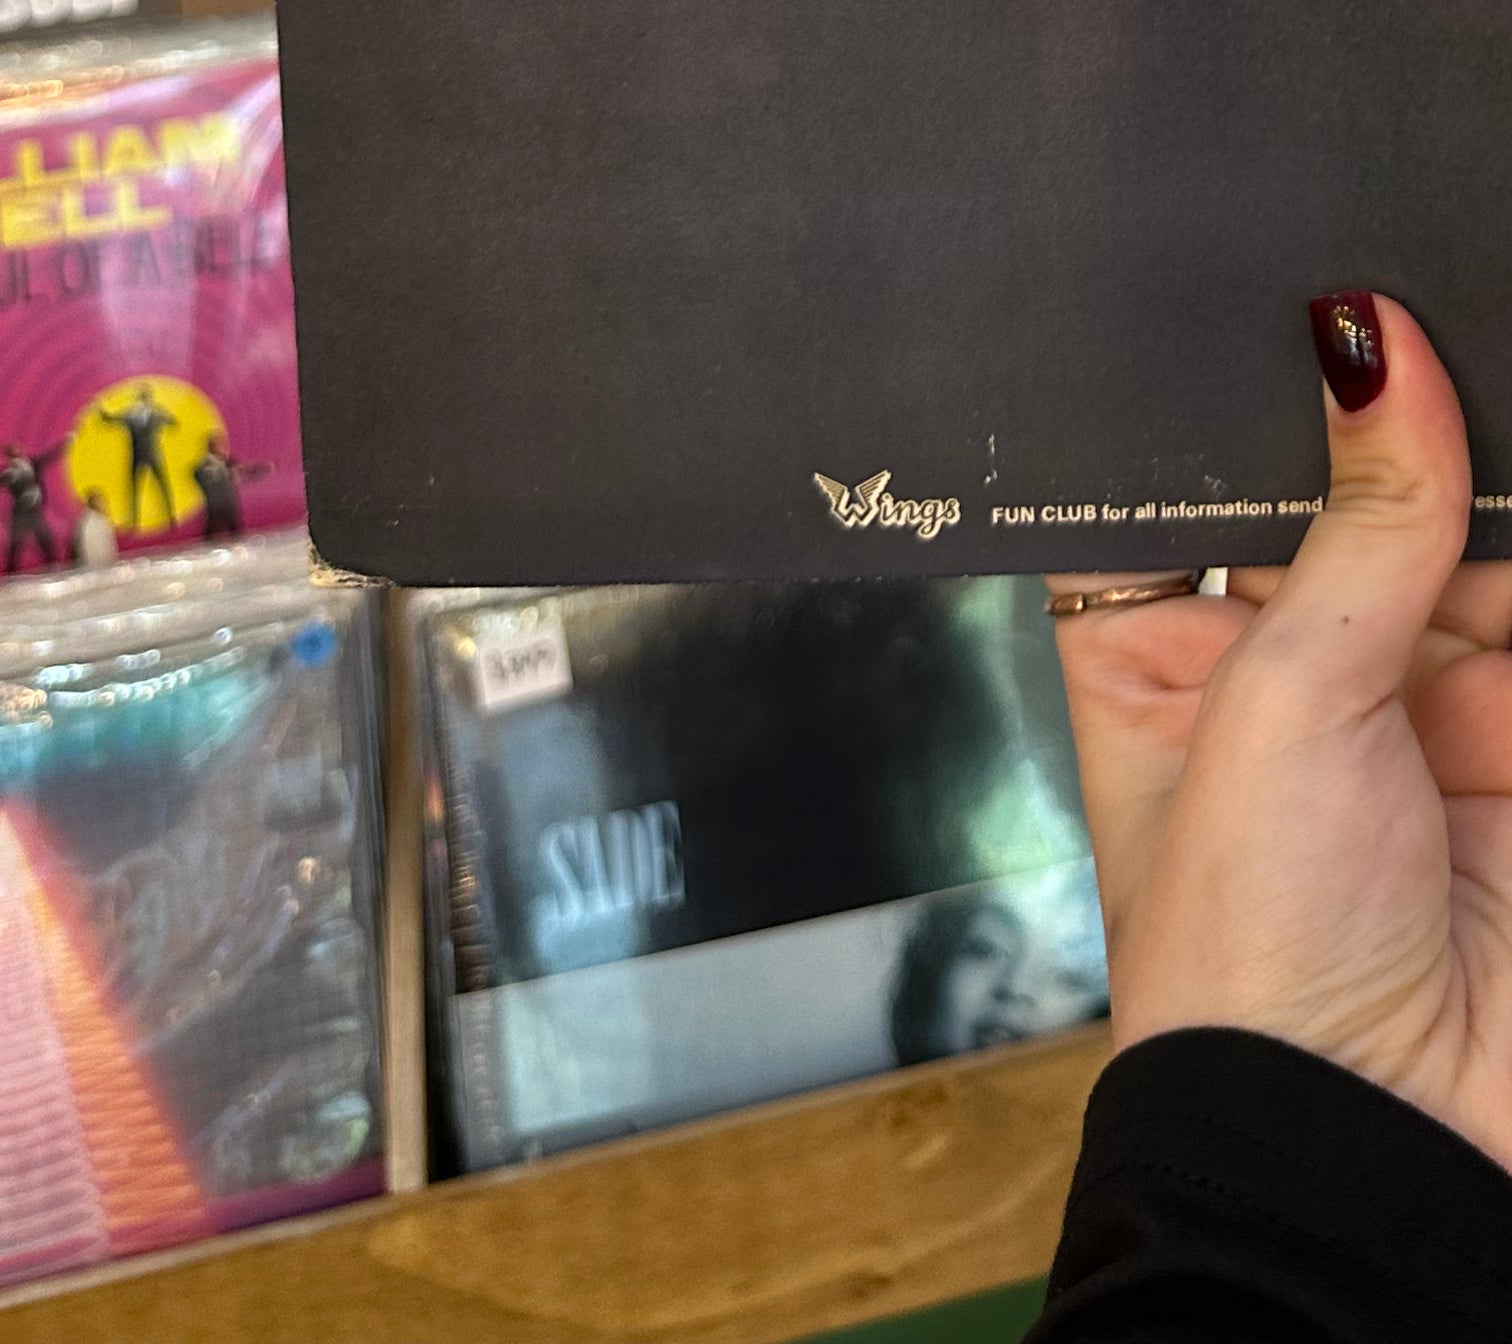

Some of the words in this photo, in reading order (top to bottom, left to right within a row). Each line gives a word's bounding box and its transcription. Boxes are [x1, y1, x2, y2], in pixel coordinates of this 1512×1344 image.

[0, 116, 242, 194] LIAM
[0, 178, 173, 249] ELL
[814, 468, 962, 539] Wings
[991, 506, 1036, 526] FUN
[1040, 503, 1098, 524] CLUB
[1102, 503, 1130, 521] for
[1134, 502, 1157, 519] all
[1161, 498, 1273, 518] information
[1277, 496, 1324, 514] send
